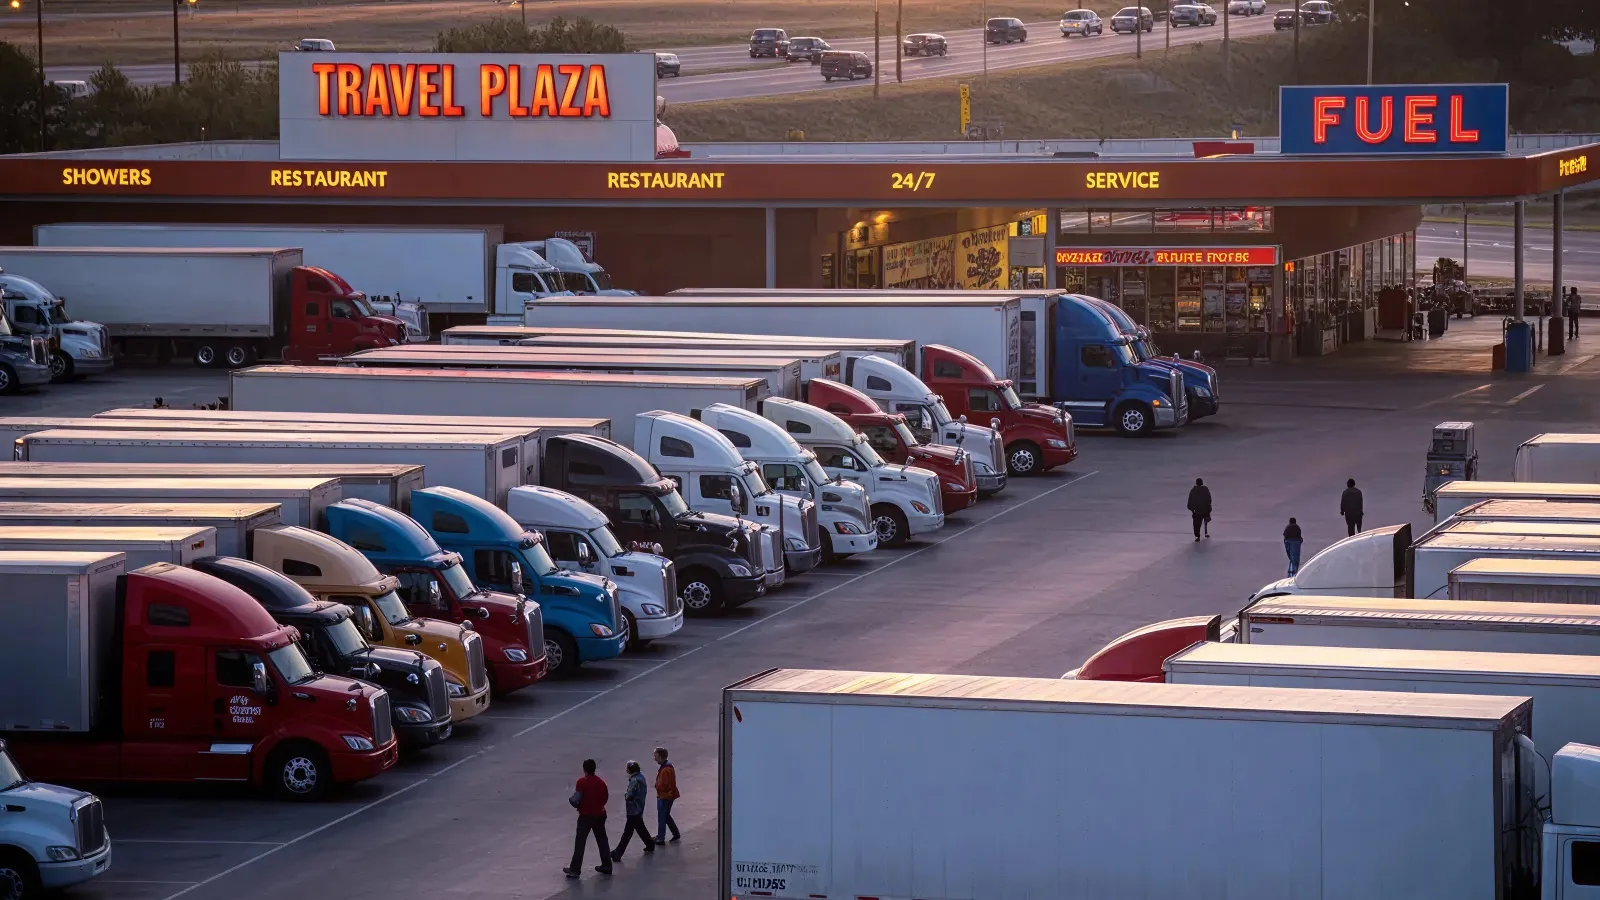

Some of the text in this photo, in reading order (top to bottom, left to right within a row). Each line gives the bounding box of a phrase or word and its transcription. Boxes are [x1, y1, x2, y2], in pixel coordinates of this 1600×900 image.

[312, 62, 611, 118] TRAVEL PLAZA
[1313, 95, 1480, 144] FUEL
[62, 168, 152, 186] SHOWERS
[270, 170, 388, 187] RESTAURANT
[607, 172, 725, 189] RESTAURANT
[891, 171, 936, 192] 24/7
[1086, 171, 1160, 189] SERVICE
